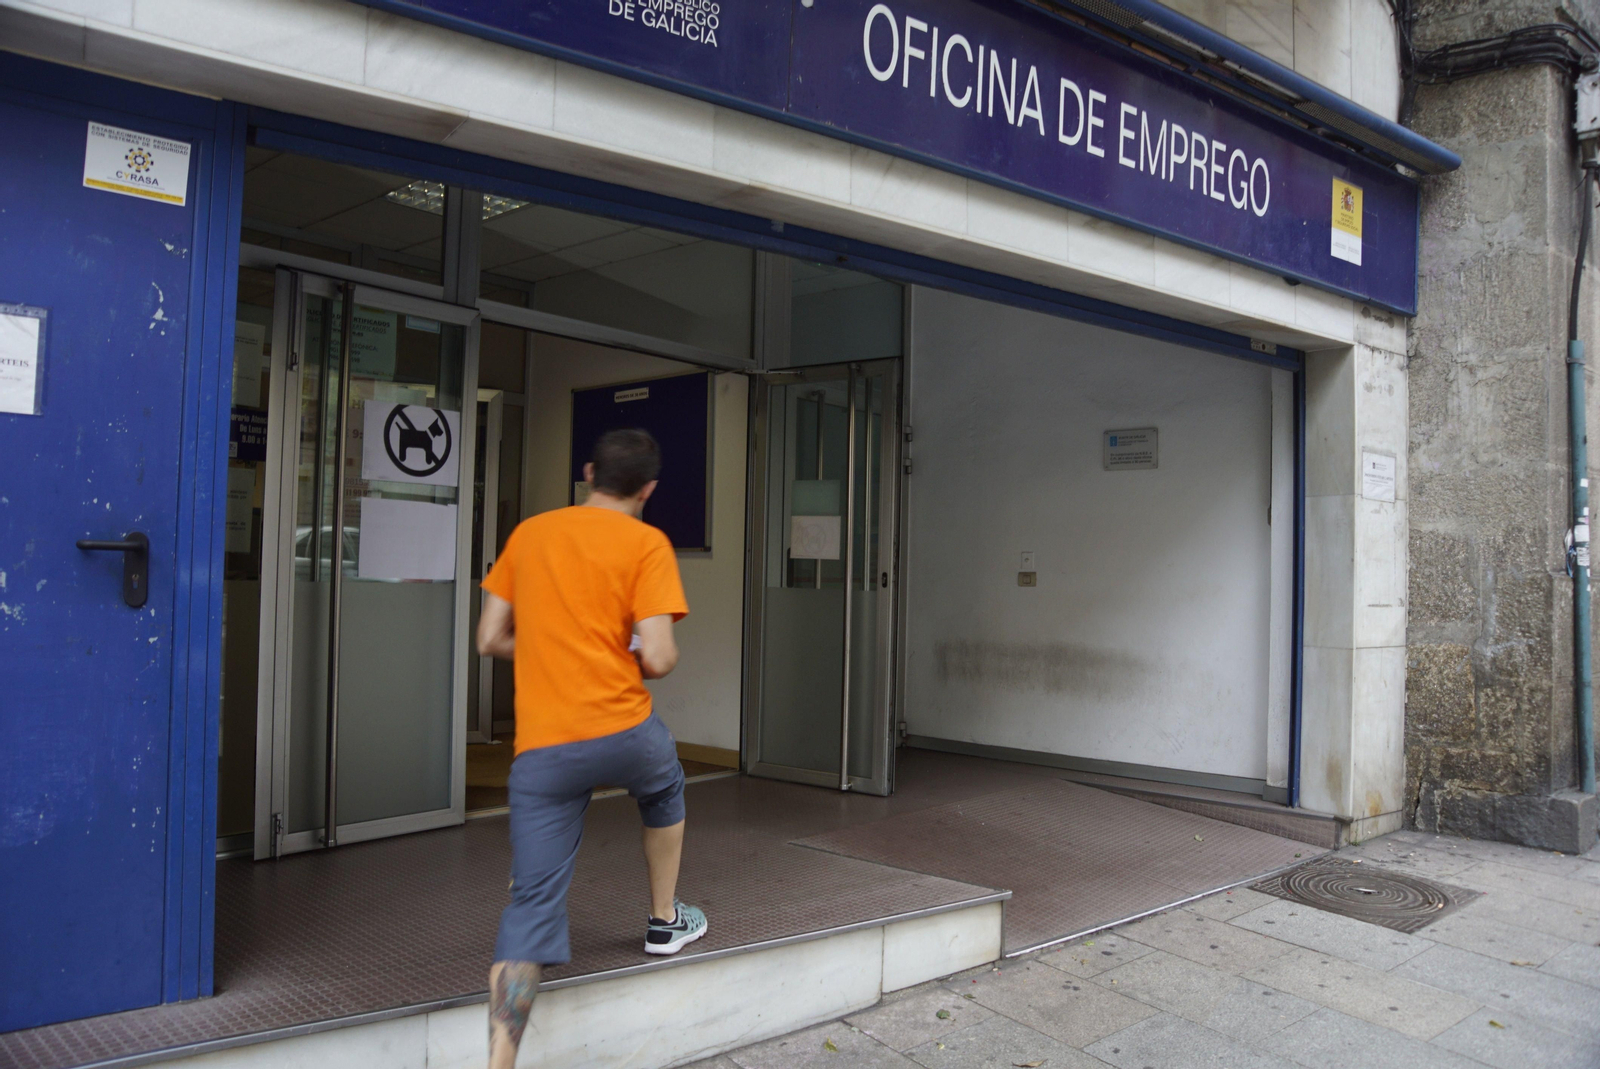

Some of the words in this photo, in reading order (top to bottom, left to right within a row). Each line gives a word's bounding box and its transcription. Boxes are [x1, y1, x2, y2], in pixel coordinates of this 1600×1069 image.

[608, 0, 635, 21] DE
[641, 8, 718, 48] GALICIA
[863, 3, 1045, 136] OFICINA
[1058, 77, 1107, 158] DE
[1118, 101, 1271, 218] EMPREGO
[91, 125, 151, 142] ESTABLECIMIENTO
[153, 138, 189, 152] PROTEGIDO
[108, 134, 140, 145] SISTEMAS
[153, 144, 189, 156] SEGURIDAD
[115, 170, 159, 187] CYRASA
[231, 414, 250, 423] orario
